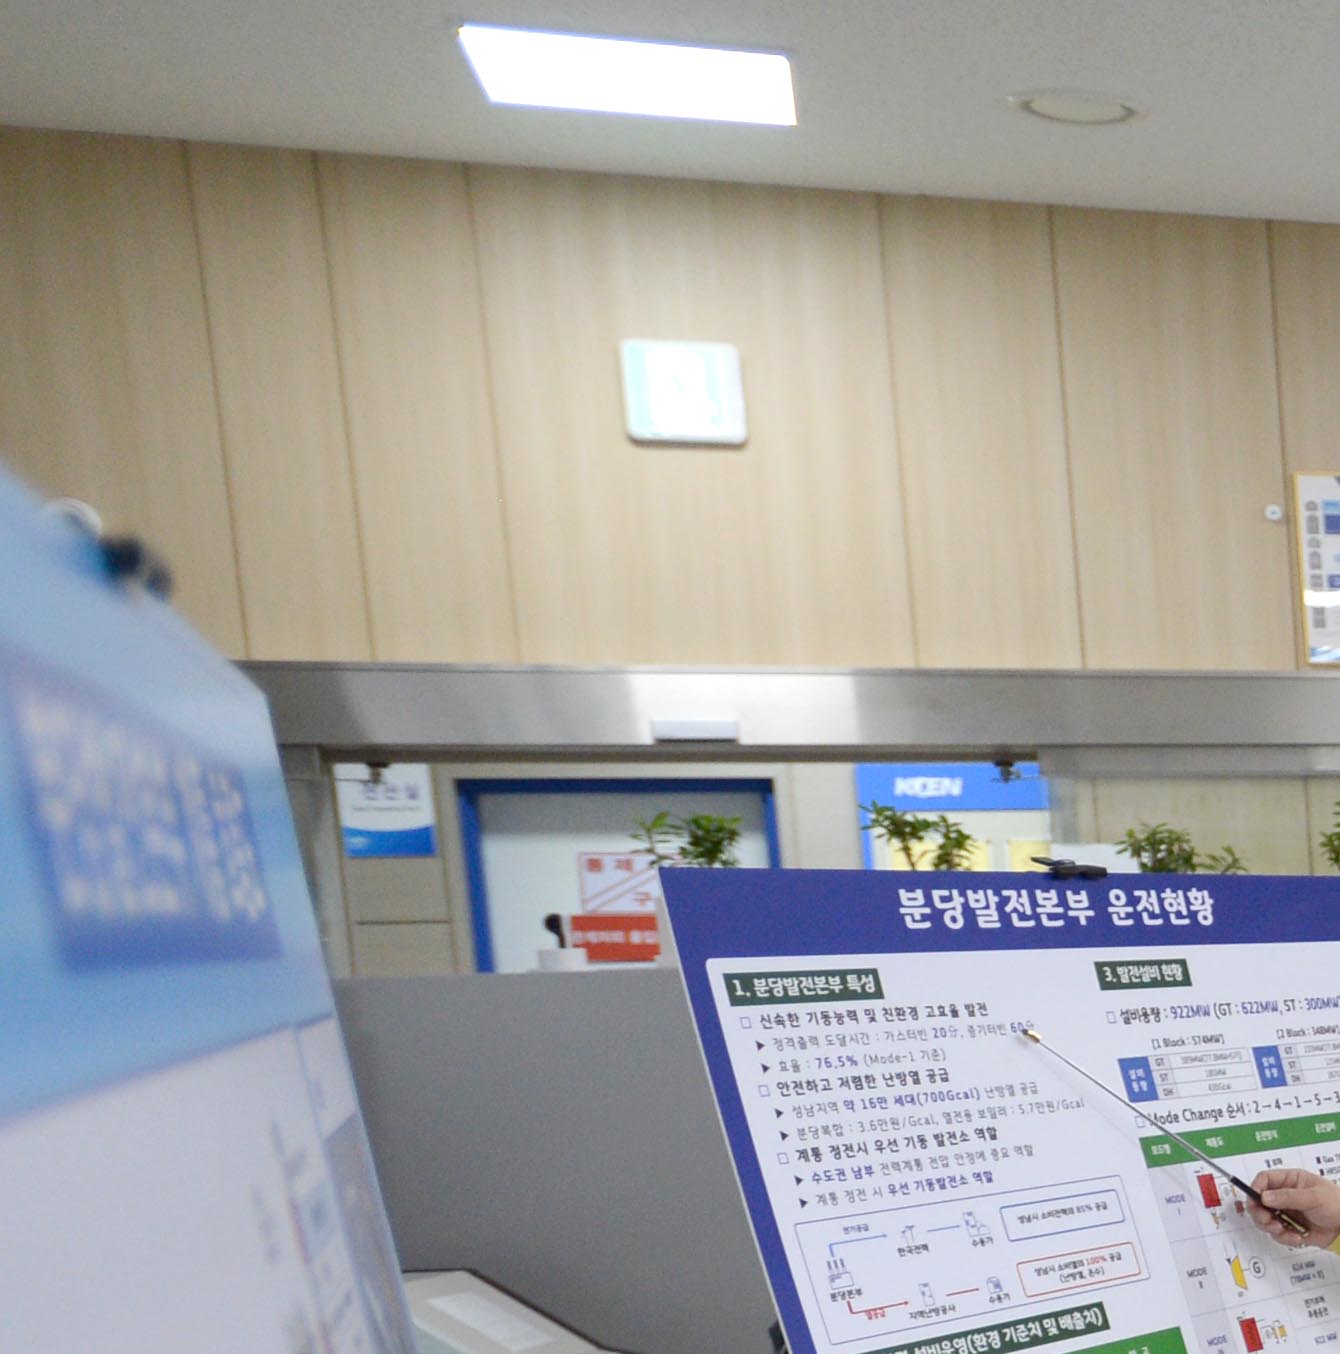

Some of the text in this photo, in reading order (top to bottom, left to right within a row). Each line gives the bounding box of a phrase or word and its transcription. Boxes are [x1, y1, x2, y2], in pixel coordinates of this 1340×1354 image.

[898, 886, 1215, 930] 분당발전본부 운전현황
[753, 975, 844, 998] 분당발전본부
[846, 973, 876, 994] 특성
[760, 1001, 989, 1030] 신속한 기동능력 및 친환경 고효율 발전
[1169, 1003, 1211, 1019] 922MW
[814, 1054, 859, 1071] 76.5%
[776, 1066, 950, 1098] 안전하고 저렴한 난방열 공급
[1182, 1104, 1224, 1123] Change
[874, 1139, 900, 1155] 우선
[932, 1130, 972, 1147] 발전소
[811, 1166, 848, 1185] 수도권
[1002, 1322, 1043, 1344] 기준치
